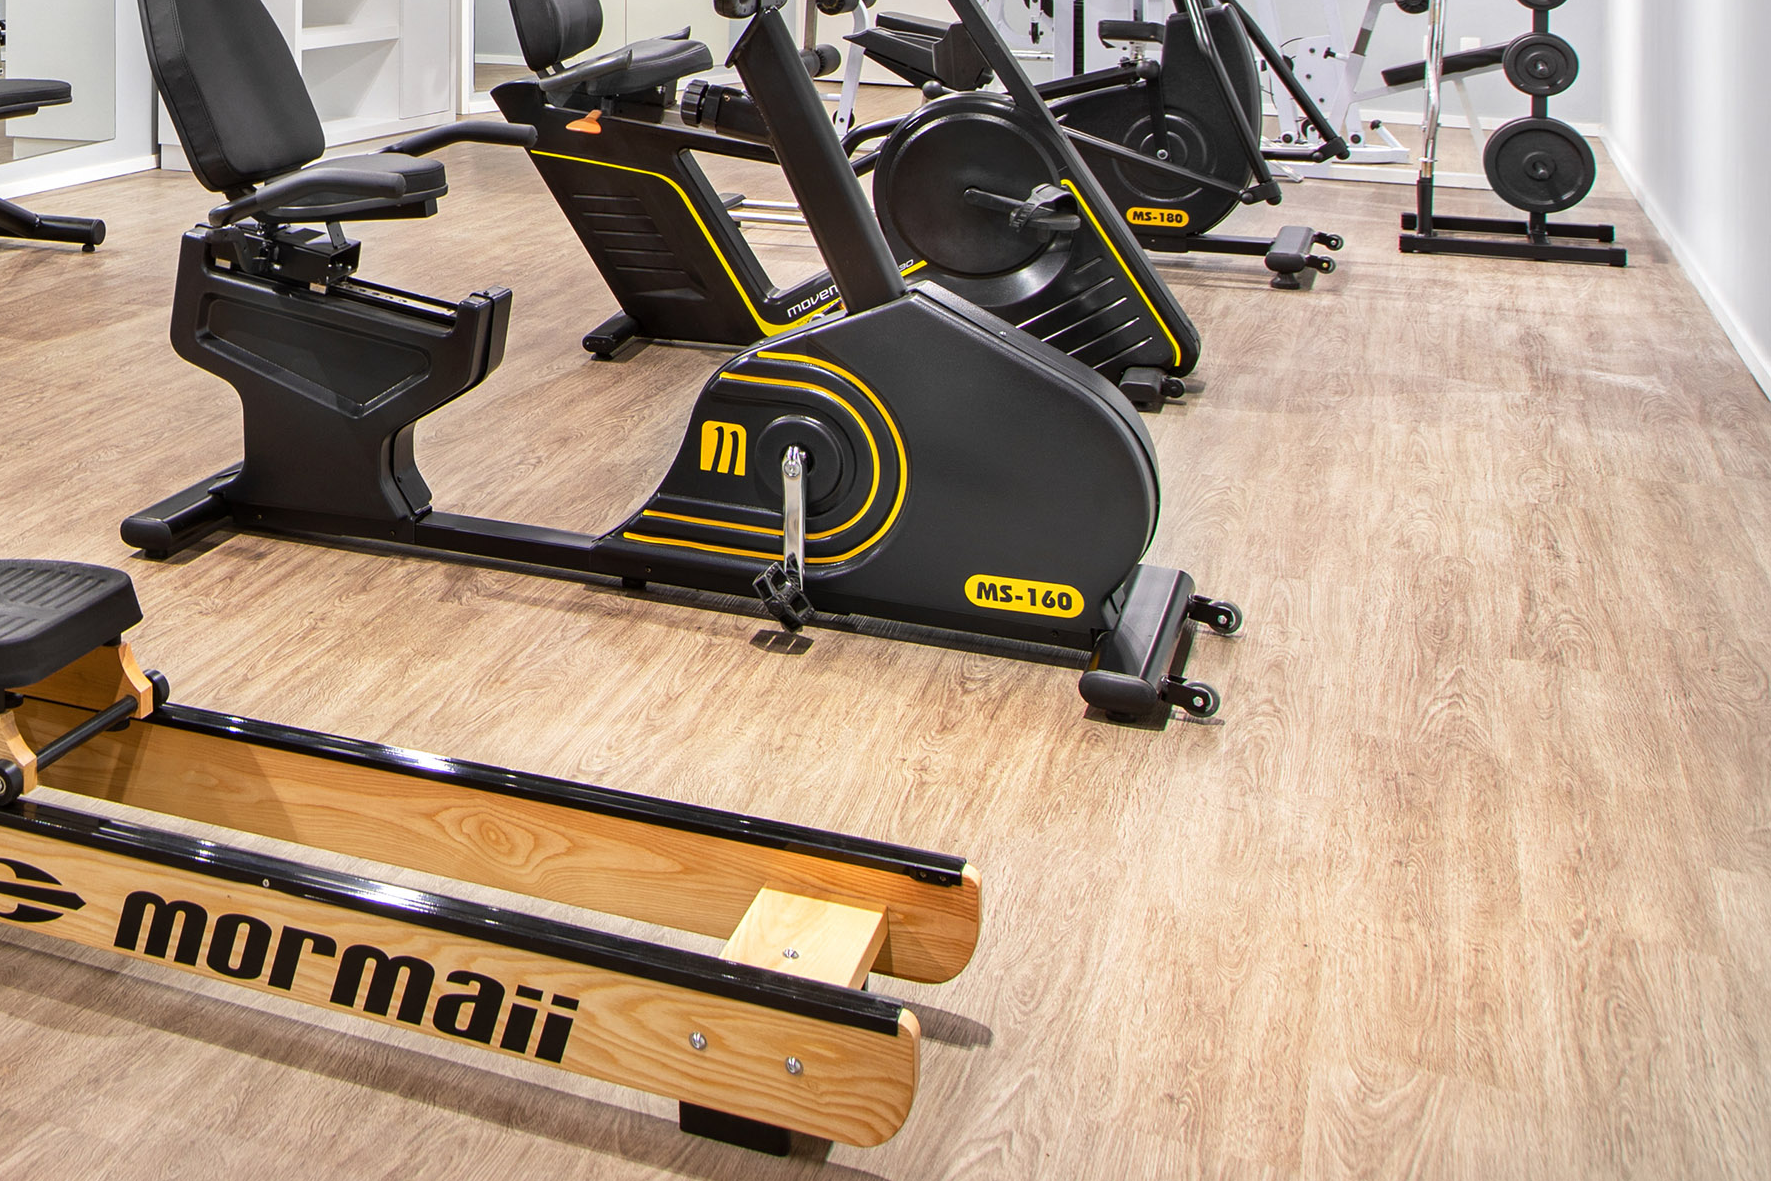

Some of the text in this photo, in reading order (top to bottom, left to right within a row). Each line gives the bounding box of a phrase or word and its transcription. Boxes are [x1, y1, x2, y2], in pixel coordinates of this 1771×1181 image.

[1132, 211, 1183, 224] MS-180
[976, 581, 1073, 611] MS-160
[113, 890, 580, 1064] mormaii
